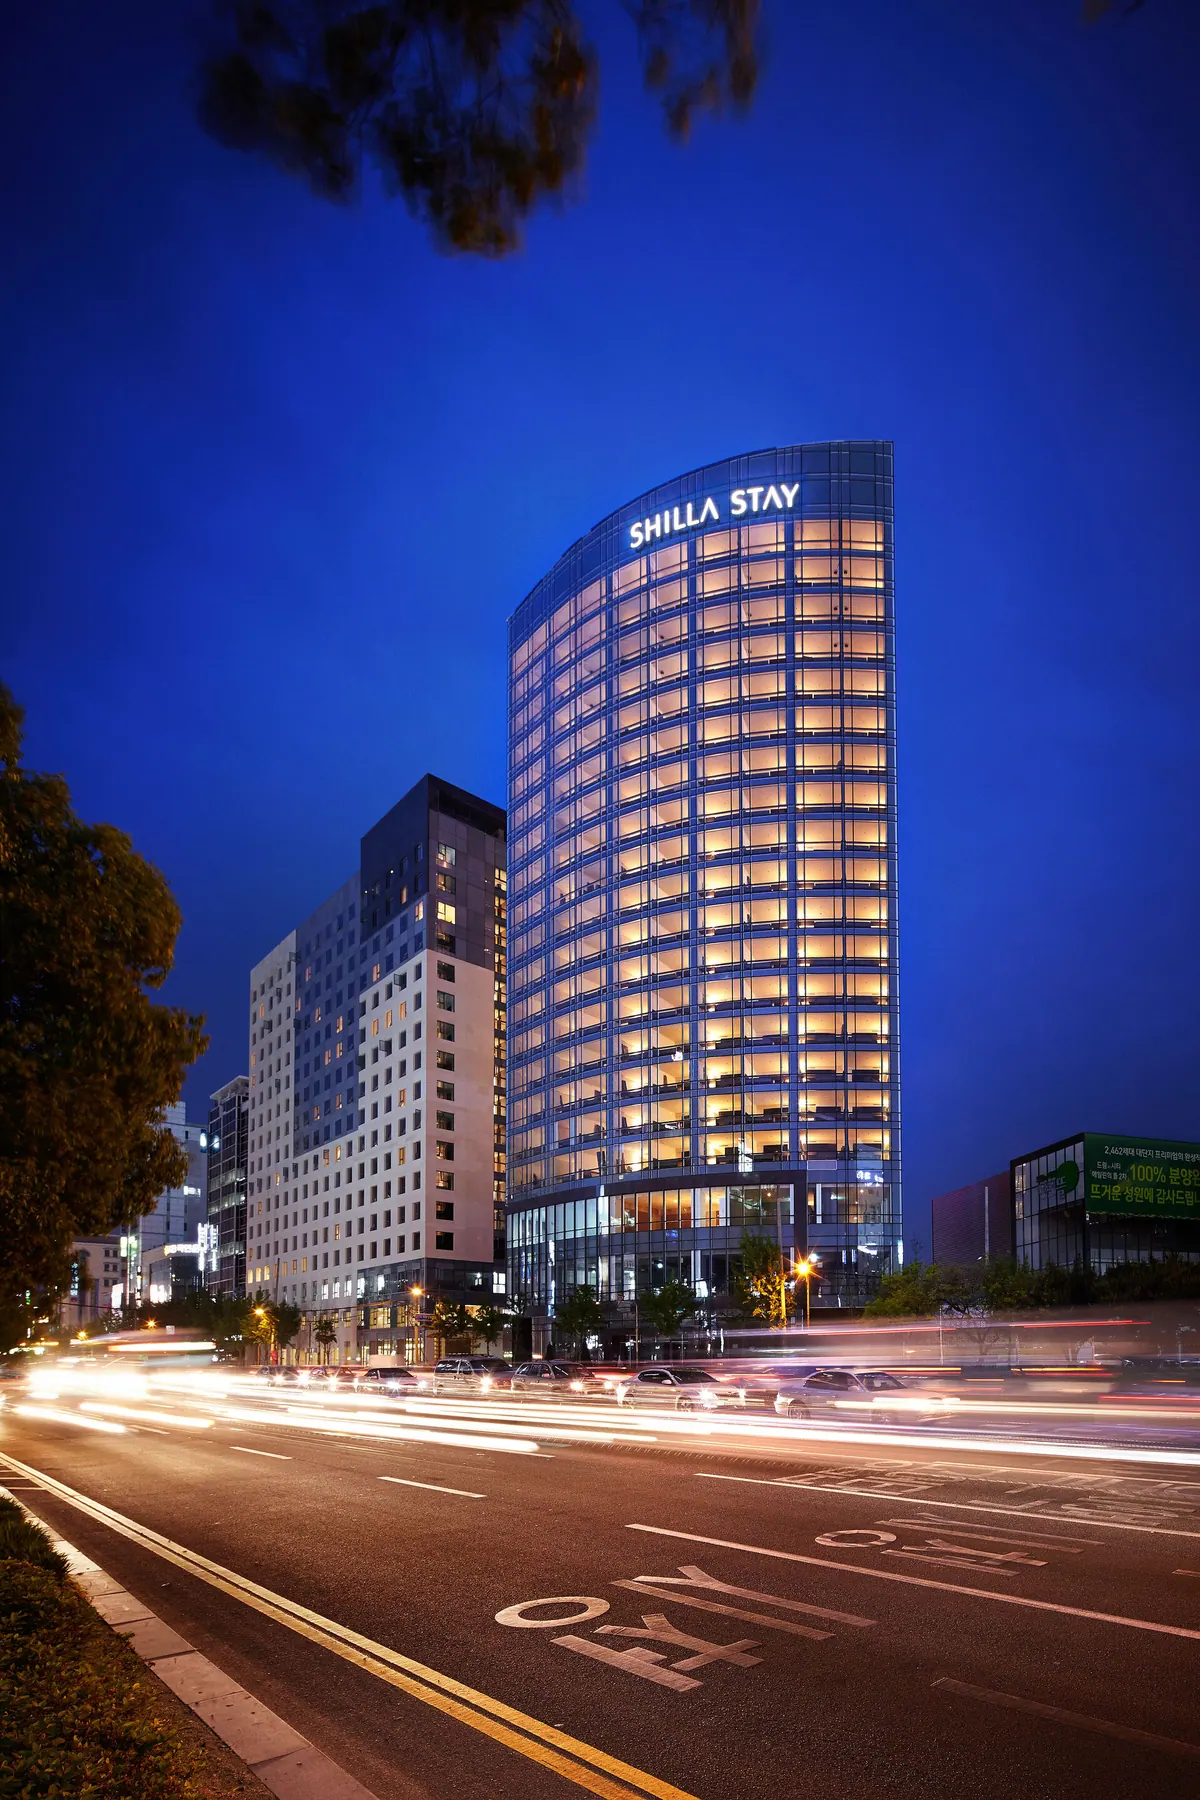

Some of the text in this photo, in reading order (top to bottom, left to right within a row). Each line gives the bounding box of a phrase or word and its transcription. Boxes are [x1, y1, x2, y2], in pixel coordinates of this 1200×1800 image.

[629, 483, 800, 549] SHILLA STAY
[1129, 1164, 1167, 1184] 100%
[1136, 1148, 1154, 1159] 대단지
[1154, 1150, 1184, 1162] 프리미엄의
[1090, 1183, 1122, 1201] 뜨거운
[1123, 1186, 1154, 1204] 성원에
[814, 1512, 1107, 1577] 시청
[495, 1565, 878, 1692] 시청
